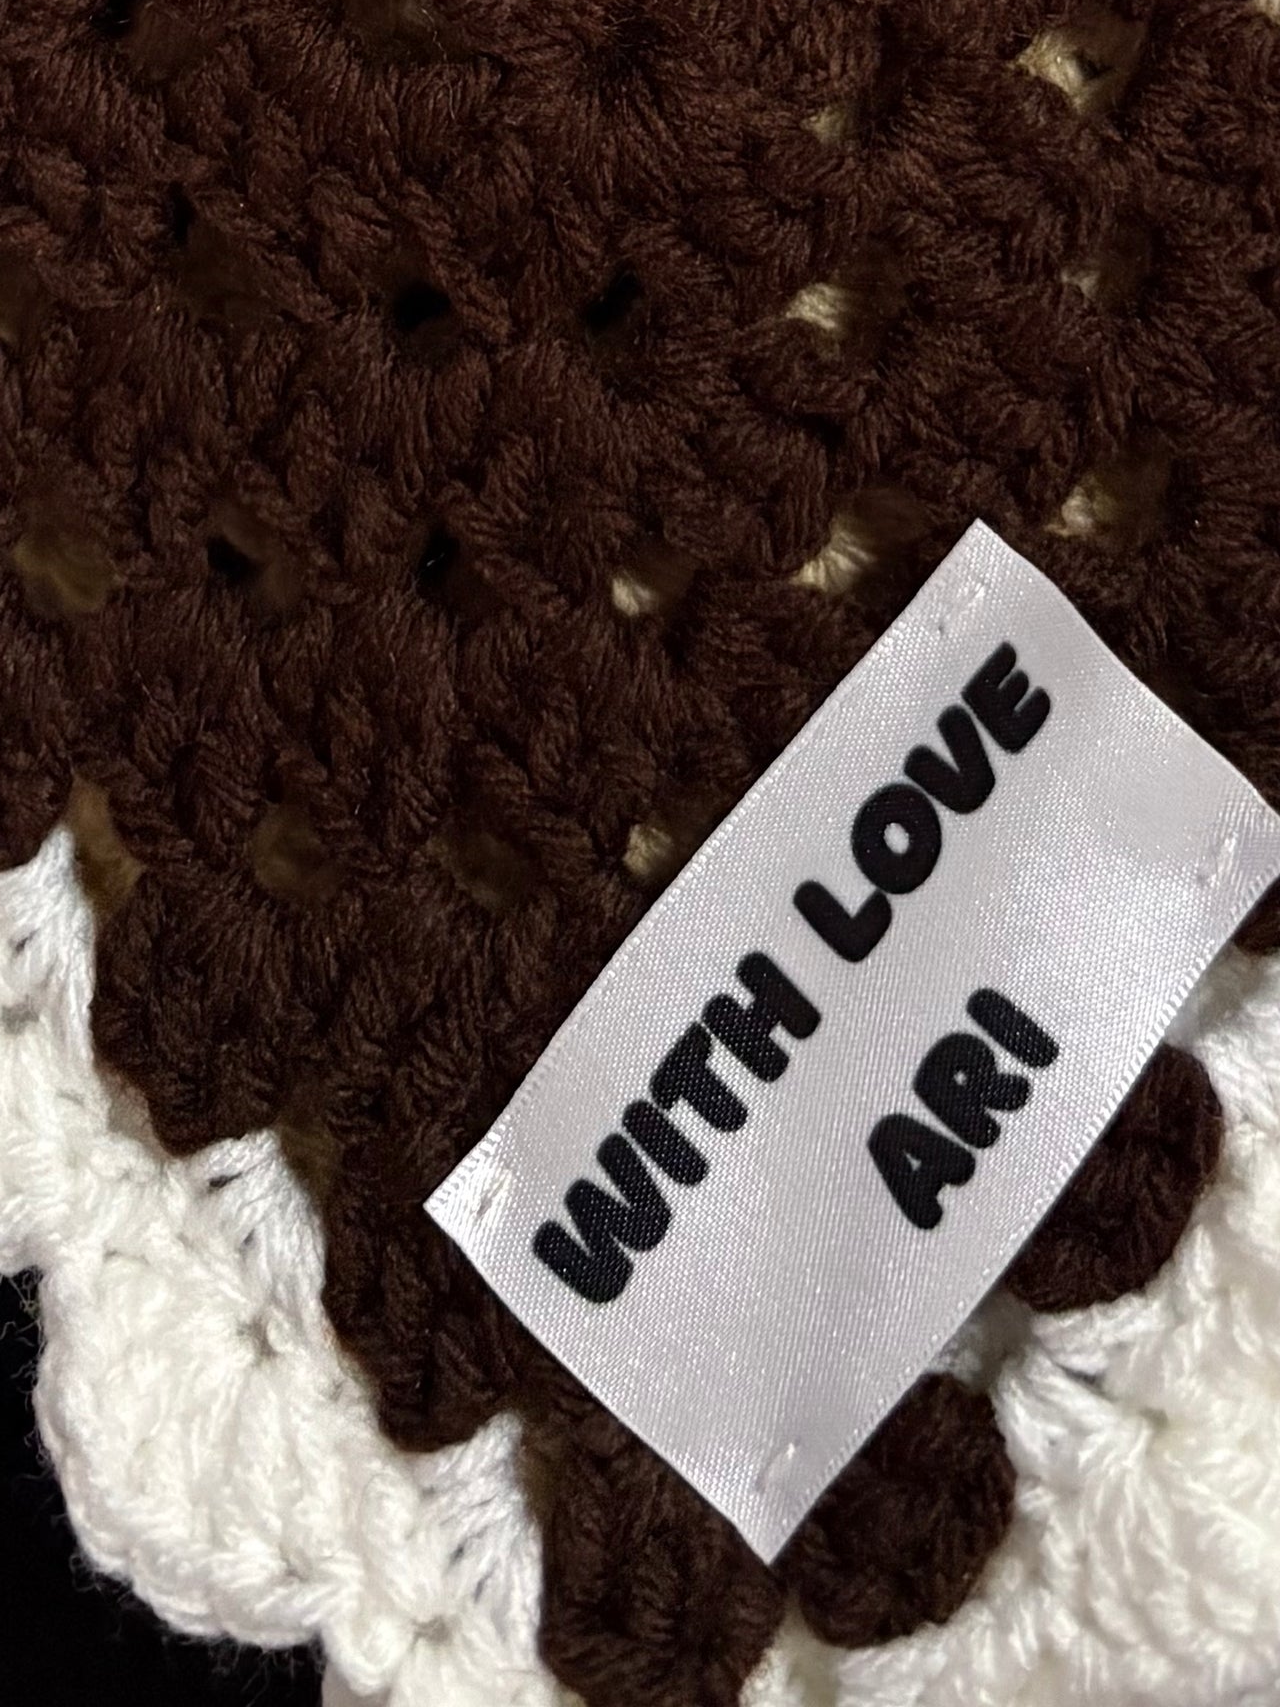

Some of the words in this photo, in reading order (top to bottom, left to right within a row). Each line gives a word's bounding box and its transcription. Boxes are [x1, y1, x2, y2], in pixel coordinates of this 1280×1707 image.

[531, 950, 823, 1307] WITH
[791, 640, 1052, 965] LOVE
[865, 987, 1061, 1232] ARI
